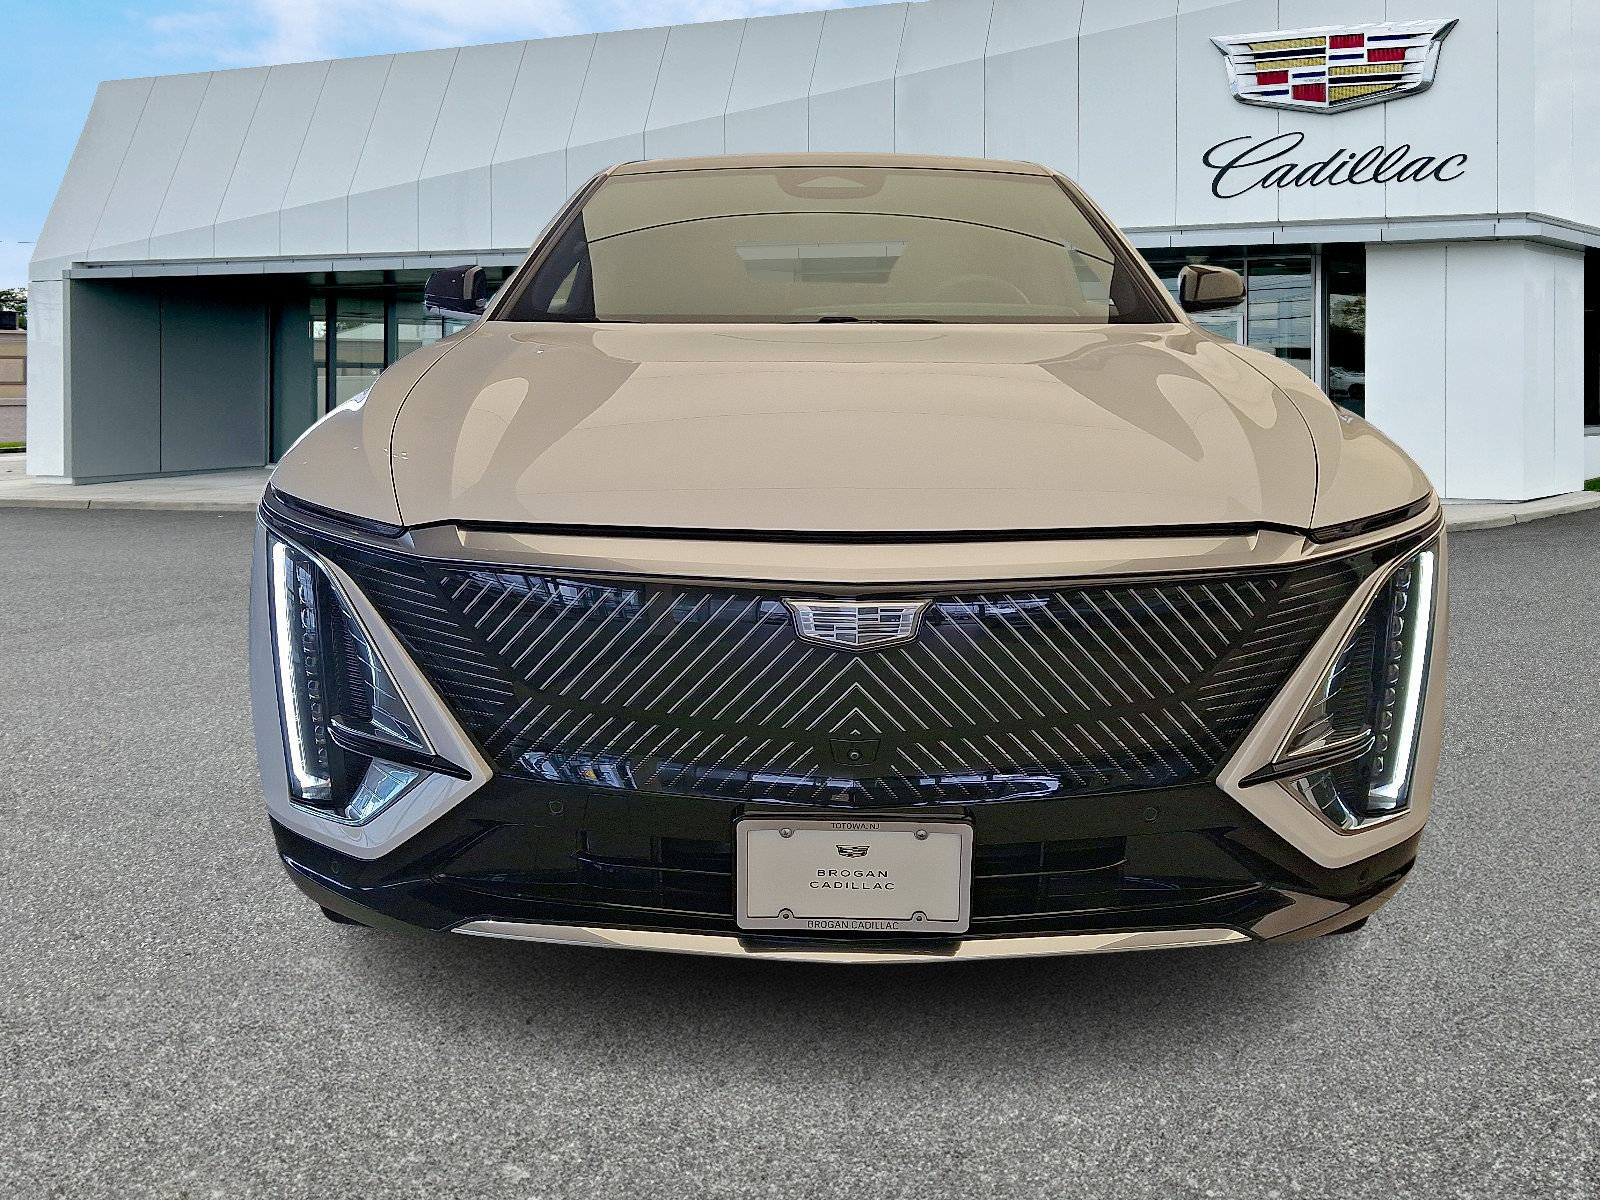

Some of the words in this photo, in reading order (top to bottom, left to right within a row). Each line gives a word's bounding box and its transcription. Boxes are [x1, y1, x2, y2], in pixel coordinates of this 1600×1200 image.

[1202, 131, 1468, 199] Cadillac
[817, 870, 888, 878] BROGAN
[809, 881, 895, 890] CADILLAC
[807, 920, 849, 929] BROGAN
[851, 921, 899, 930] CADILLAC
